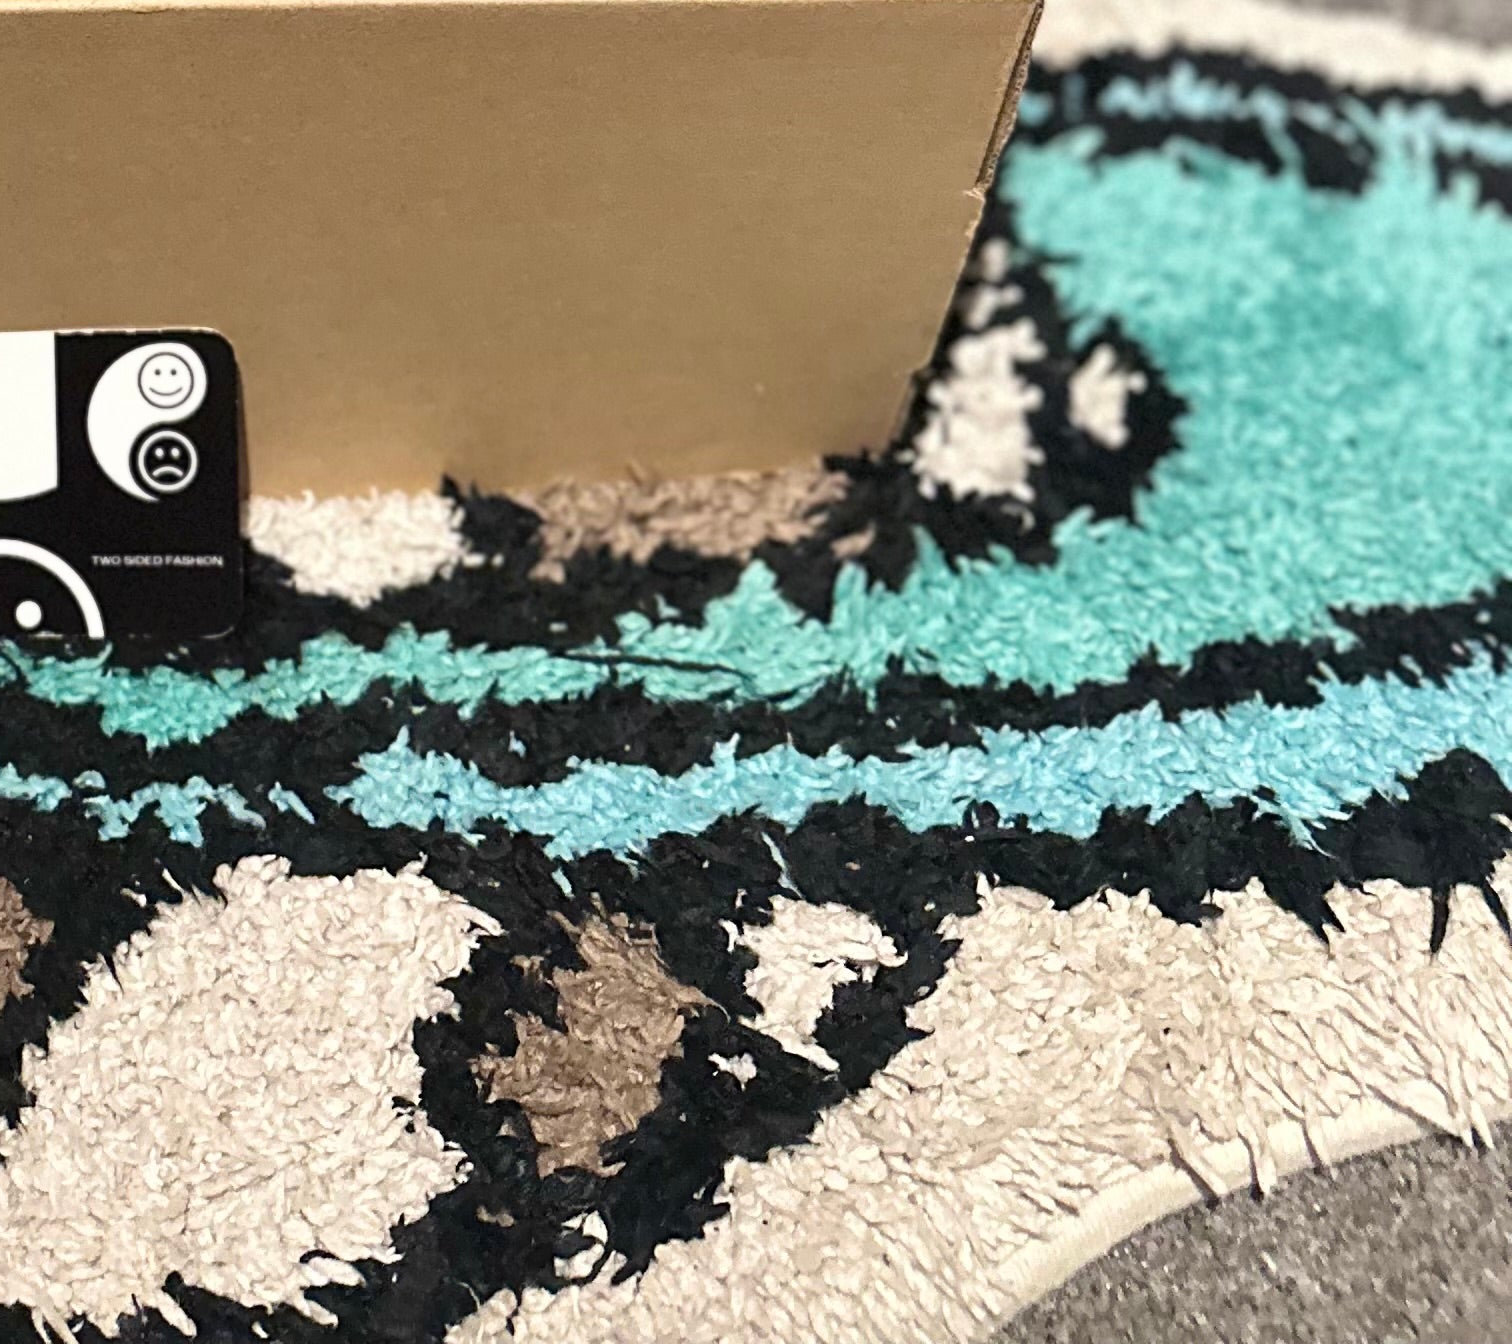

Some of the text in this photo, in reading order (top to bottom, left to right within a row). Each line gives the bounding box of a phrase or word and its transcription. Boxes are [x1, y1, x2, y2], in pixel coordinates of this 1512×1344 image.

[91, 555, 224, 568] TWO SIDED FASHION
